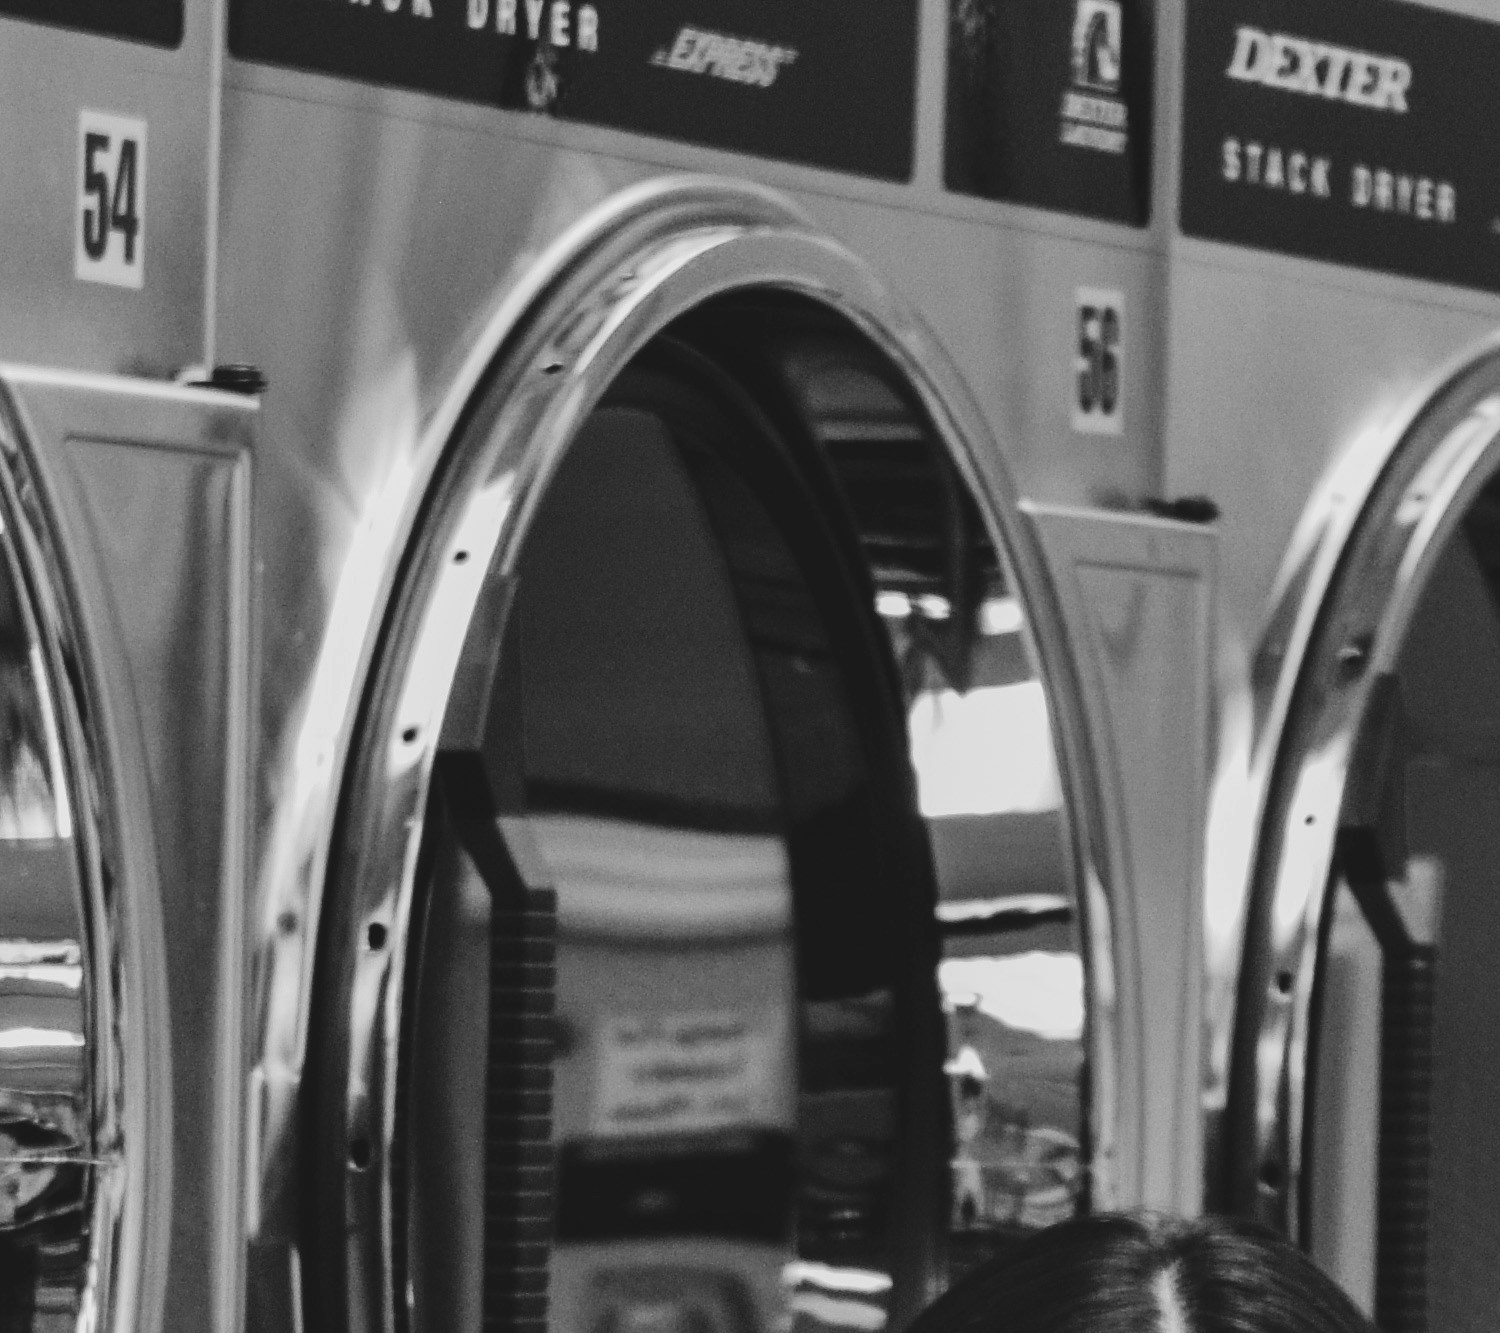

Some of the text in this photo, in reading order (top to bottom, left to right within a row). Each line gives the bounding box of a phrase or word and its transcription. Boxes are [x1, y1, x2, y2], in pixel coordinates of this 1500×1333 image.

[1226, 24, 1413, 113] DEXTER
[84, 131, 138, 266] 54
[1222, 136, 1457, 223] STACK DRYER
